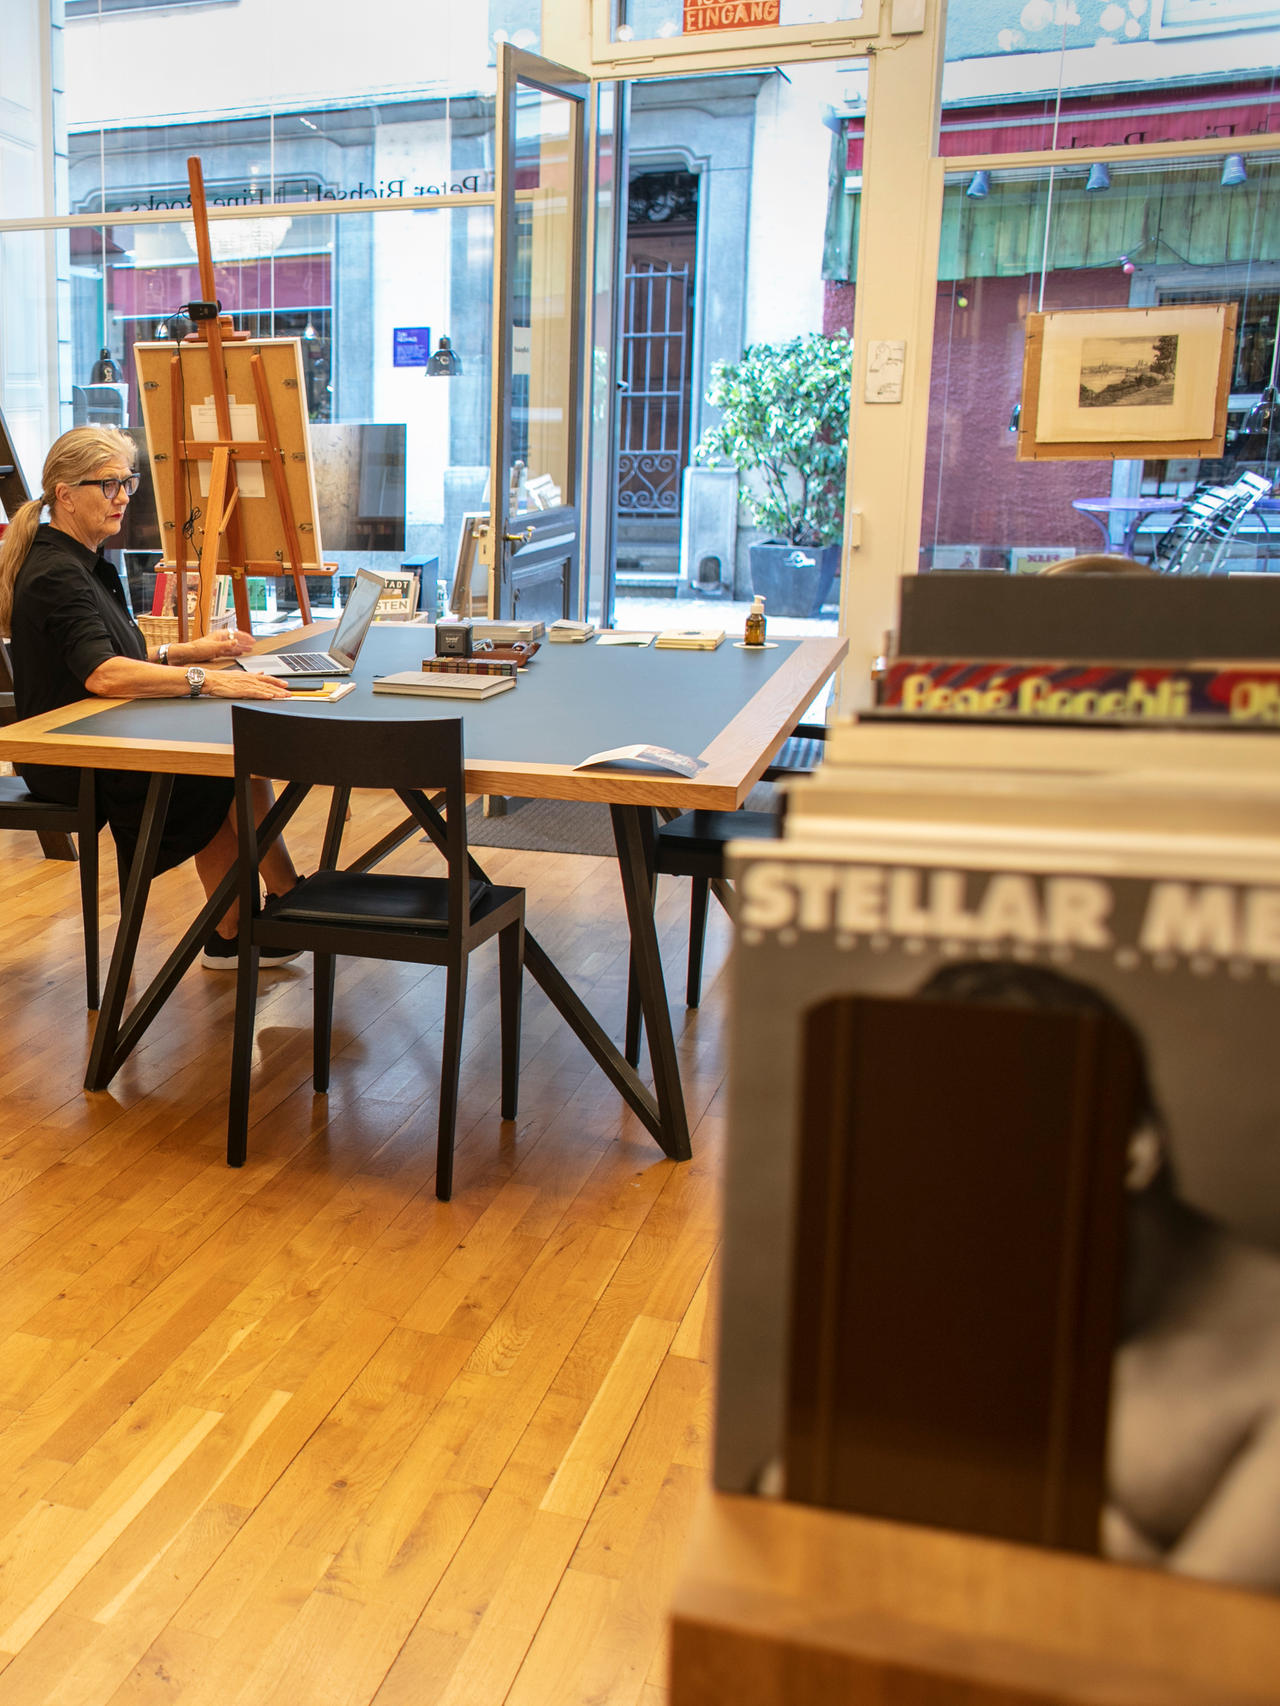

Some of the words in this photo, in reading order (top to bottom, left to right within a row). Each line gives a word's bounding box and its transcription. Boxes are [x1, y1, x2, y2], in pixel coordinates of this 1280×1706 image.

[686, 1, 778, 31] EINGANG
[741, 862, 1115, 949] STELLAR
[1139, 878, 1280, 960] ME
